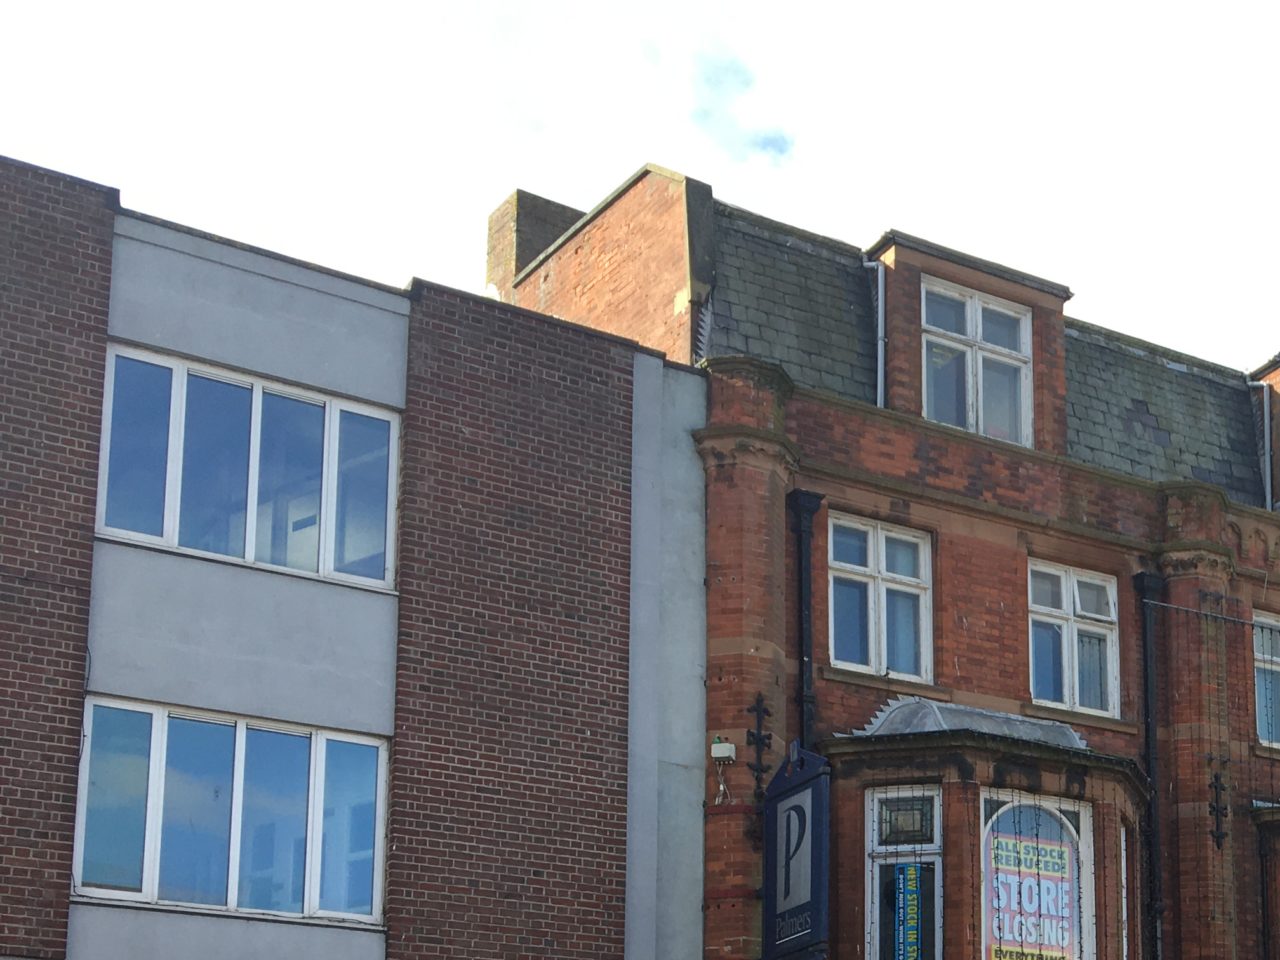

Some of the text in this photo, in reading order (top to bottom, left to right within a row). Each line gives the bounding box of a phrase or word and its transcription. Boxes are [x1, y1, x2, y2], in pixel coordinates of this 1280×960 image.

[784, 804, 807, 901] P
[995, 854, 1067, 874] REDUCED!
[996, 839, 1066, 861] ALL STOCK
[907, 866, 917, 890] NEW
[907, 893, 918, 926] STOCK
[992, 874, 1070, 918] STORE
[776, 911, 812, 939] Palmers
[907, 930, 917, 942] IN
[992, 913, 1070, 948] CLOSING
